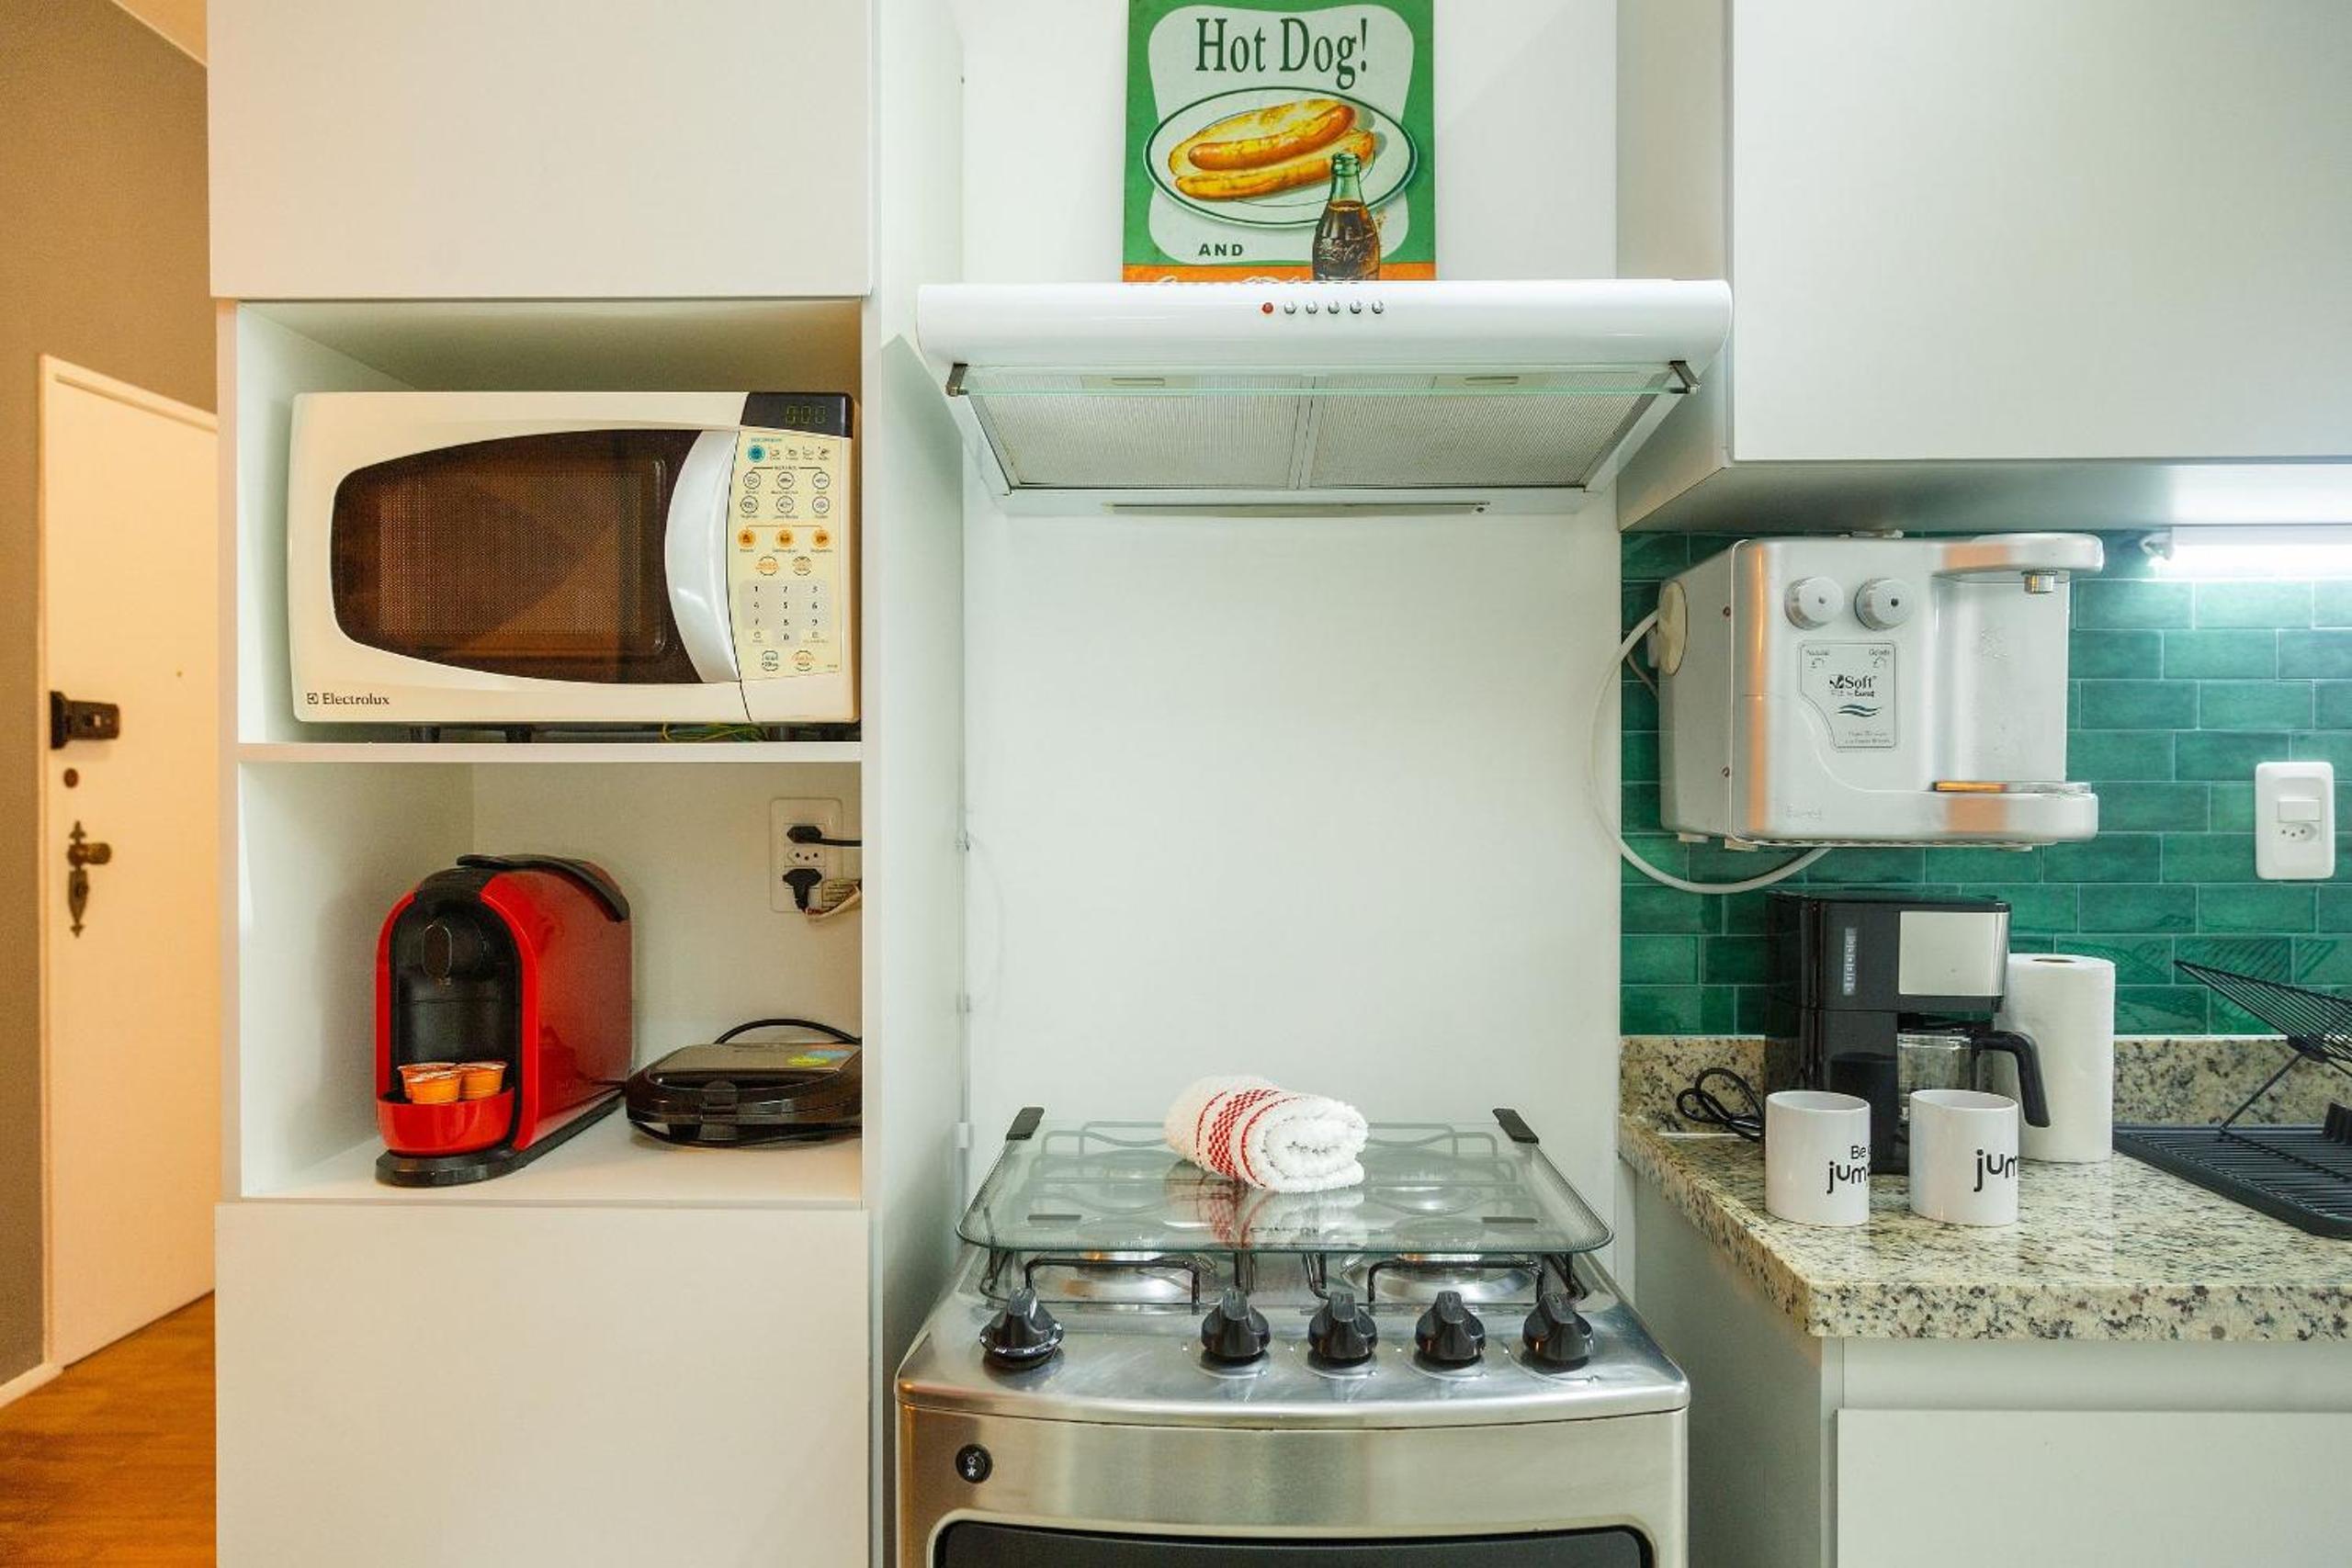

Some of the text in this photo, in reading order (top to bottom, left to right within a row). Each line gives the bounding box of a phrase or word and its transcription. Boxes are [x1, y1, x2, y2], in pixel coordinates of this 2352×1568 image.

[1195, 17, 1368, 90] Hot Dog!
[1198, 243, 1244, 257] AND
[1845, 675, 1872, 689] Soft
[322, 693, 390, 705] Electrolux
[1826, 1161, 1870, 1194] jum
